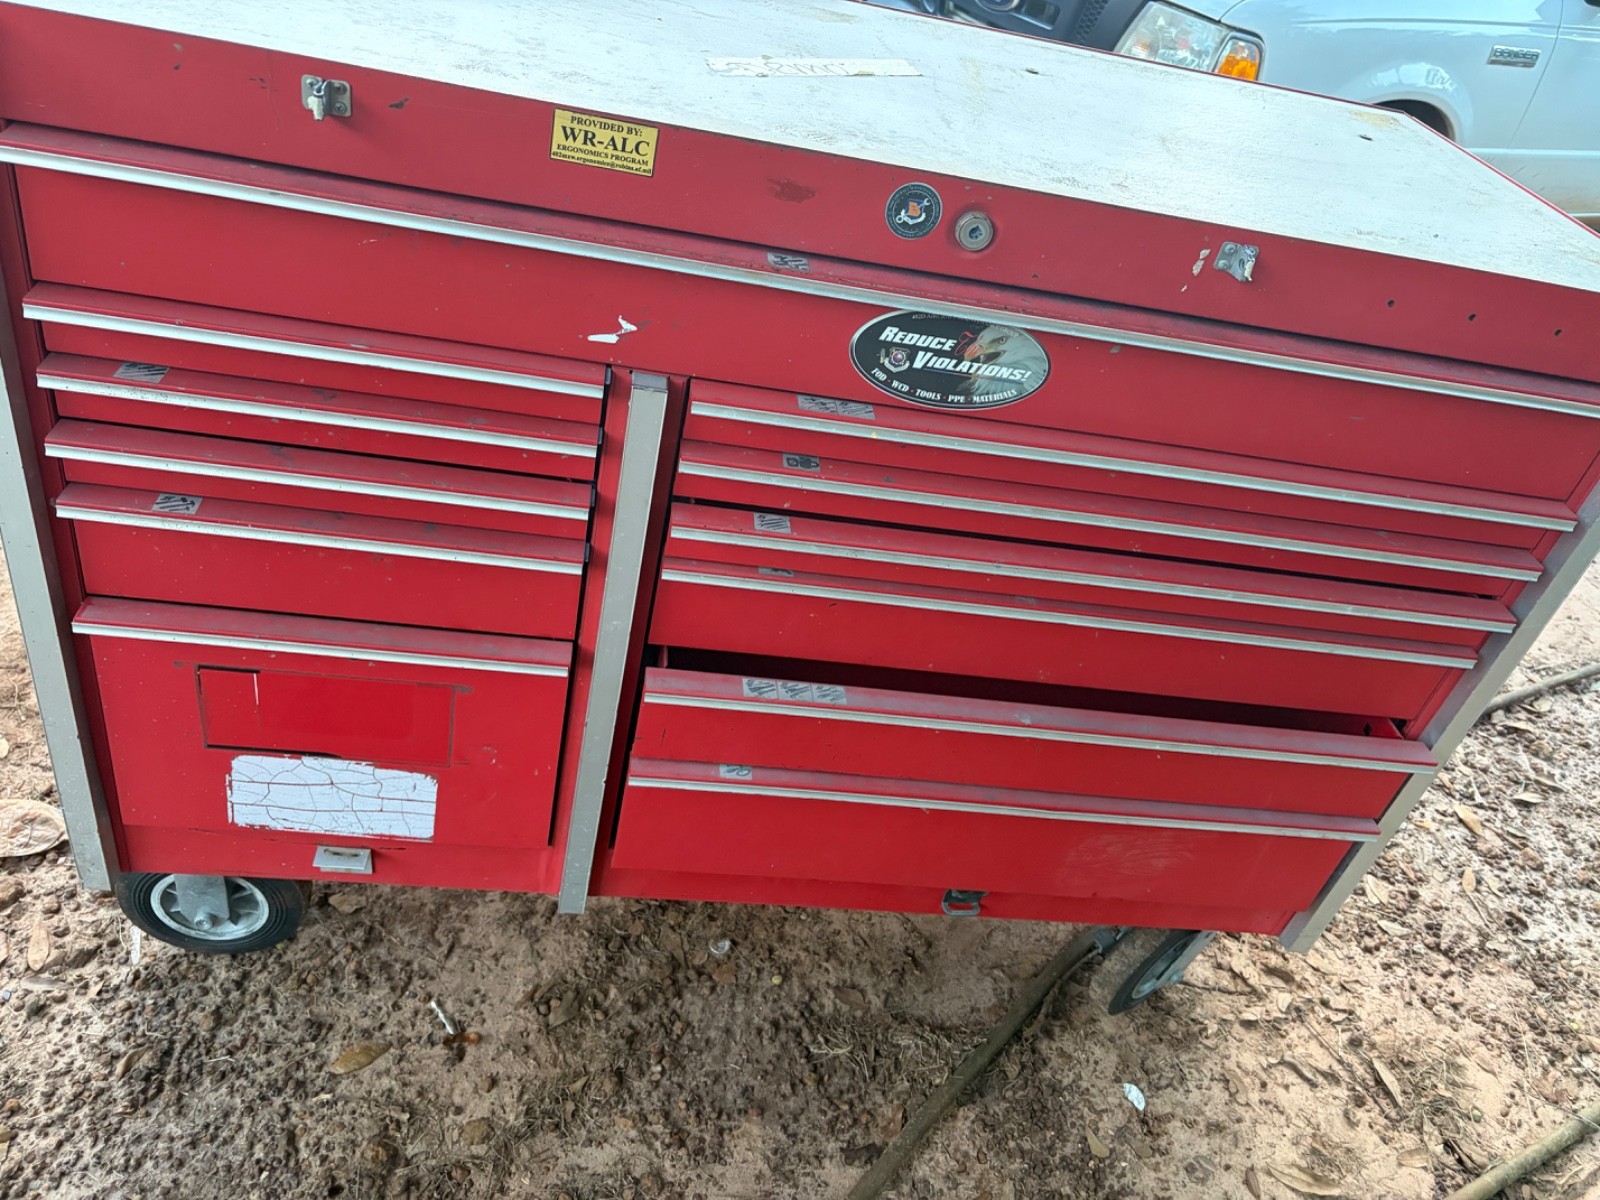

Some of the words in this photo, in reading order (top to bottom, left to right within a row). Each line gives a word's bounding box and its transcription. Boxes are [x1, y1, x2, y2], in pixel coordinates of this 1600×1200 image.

[570, 115, 624, 133] PROVIDED
[626, 126, 643, 137] BY:
[556, 143, 609, 159] ERGONOMICS
[610, 153, 649, 167] PROGRAM
[561, 125, 650, 157] WR-ALC
[879, 326, 958, 351] REDUCE
[912, 350, 1032, 382] VIOLATIONS!
[871, 367, 886, 382] FOD
[891, 378, 909, 393] WCD
[915, 388, 941, 401] TOOLS
[947, 394, 965, 404] PPE
[972, 388, 1018, 404] MATERIALS
